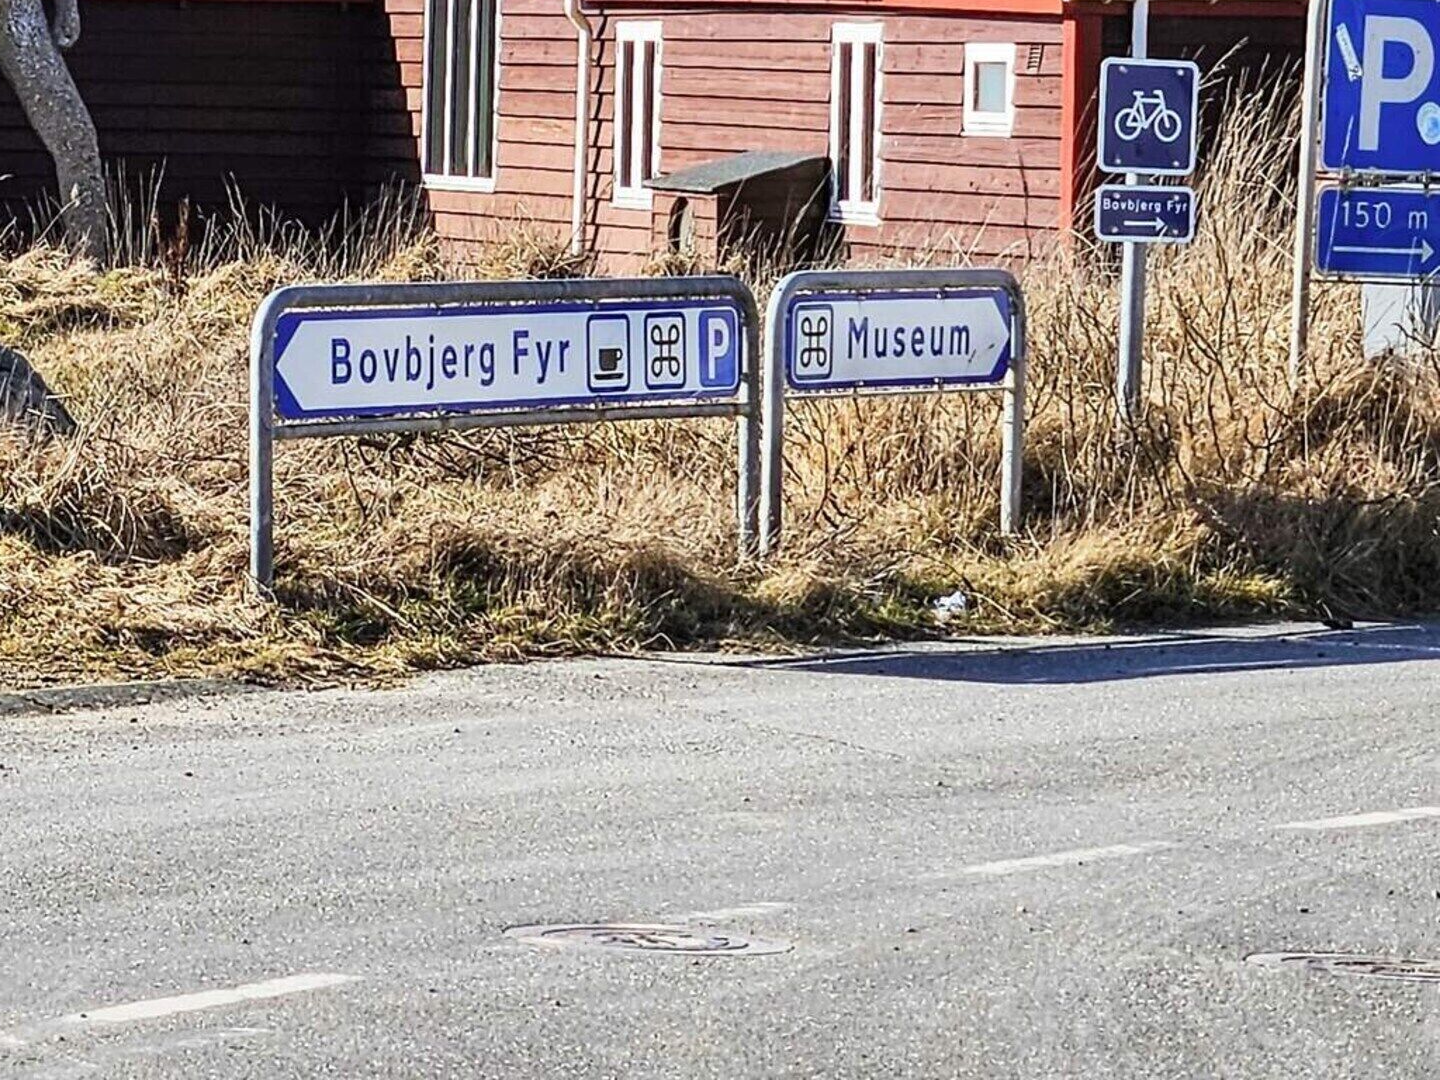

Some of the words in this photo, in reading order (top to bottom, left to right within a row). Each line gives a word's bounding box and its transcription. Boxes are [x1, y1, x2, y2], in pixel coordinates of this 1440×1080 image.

[1358, 14, 1435, 151] P
[1103, 198, 1161, 212] Bovbjerg
[1166, 200, 1187, 214] Fyr
[1342, 201, 1391, 228] 150
[1408, 211, 1428, 229] m
[331, 333, 495, 391] Bovbjerg
[512, 329, 570, 384] Fyr
[707, 317, 730, 380] P
[847, 316, 971, 360] Museum
